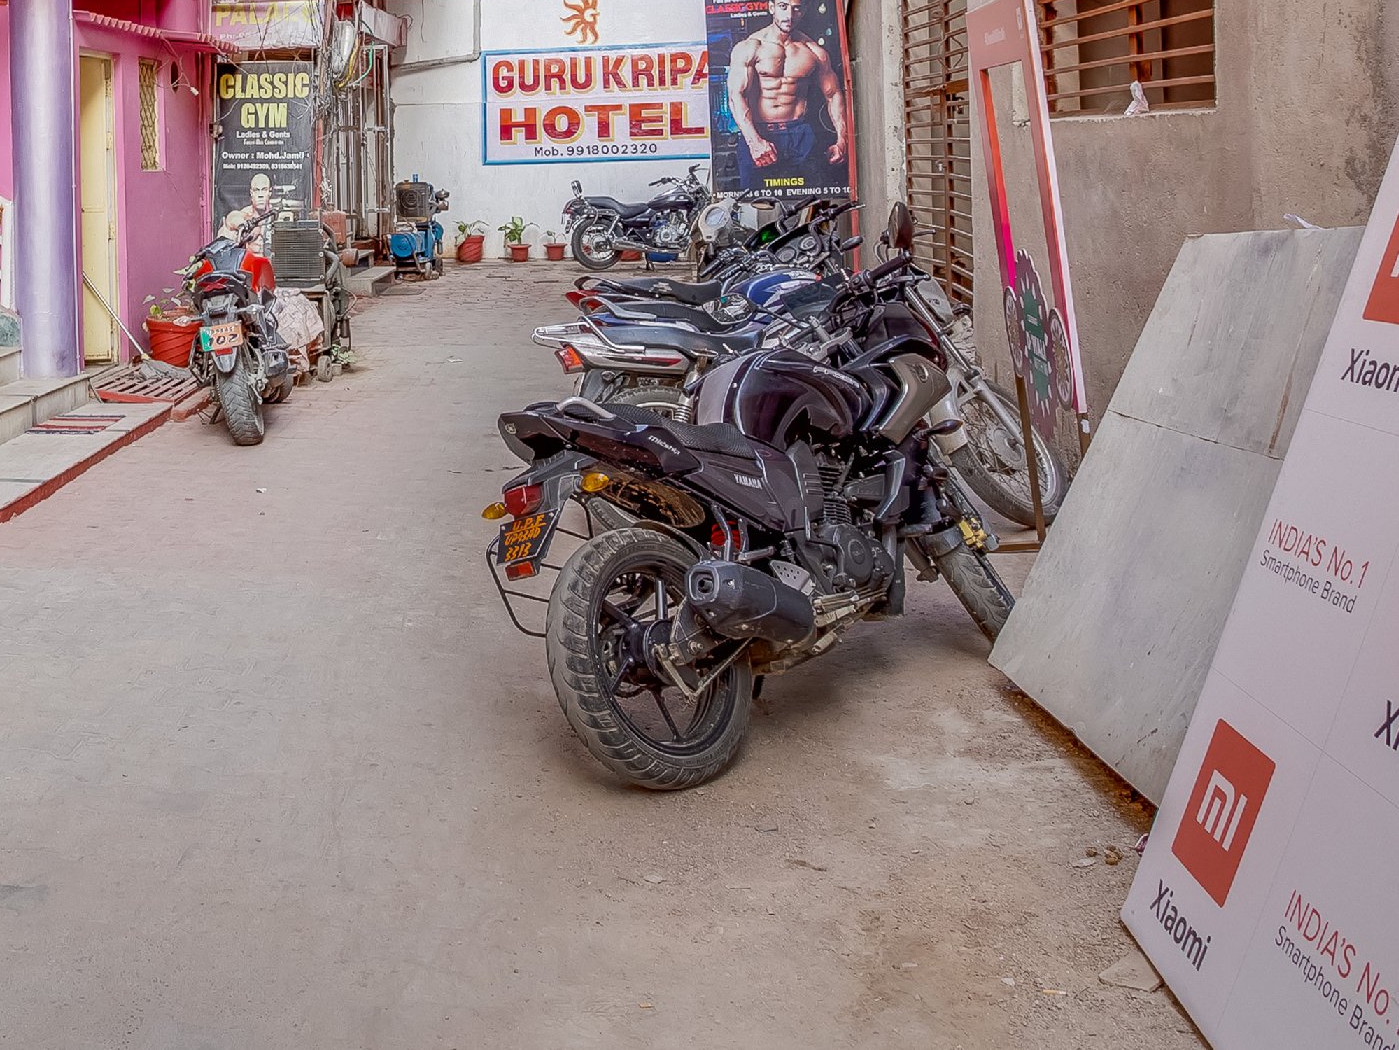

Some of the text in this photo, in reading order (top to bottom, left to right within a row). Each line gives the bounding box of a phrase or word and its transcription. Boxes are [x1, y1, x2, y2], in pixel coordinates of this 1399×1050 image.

[745, 1, 769, 11] GYM
[219, 71, 310, 100] CLASSIC
[492, 56, 596, 98] GURU
[240, 102, 288, 129] GYM
[499, 101, 709, 145] HOTEL
[236, 130, 261, 139] Ladies
[760, 189, 772, 197] TO
[786, 187, 822, 196] EVENING
[829, 186, 841, 195] TO
[763, 176, 805, 188] TIMINGS
[733, 472, 764, 490] YAMAHA
[1267, 517, 1327, 567] INDIA'S
[1259, 549, 1357, 614] Smartphone Brand
[1150, 878, 1212, 972] Xiaomi
[1284, 888, 1357, 979] INDIA'S
[1274, 925, 1349, 1016] Smartphone
